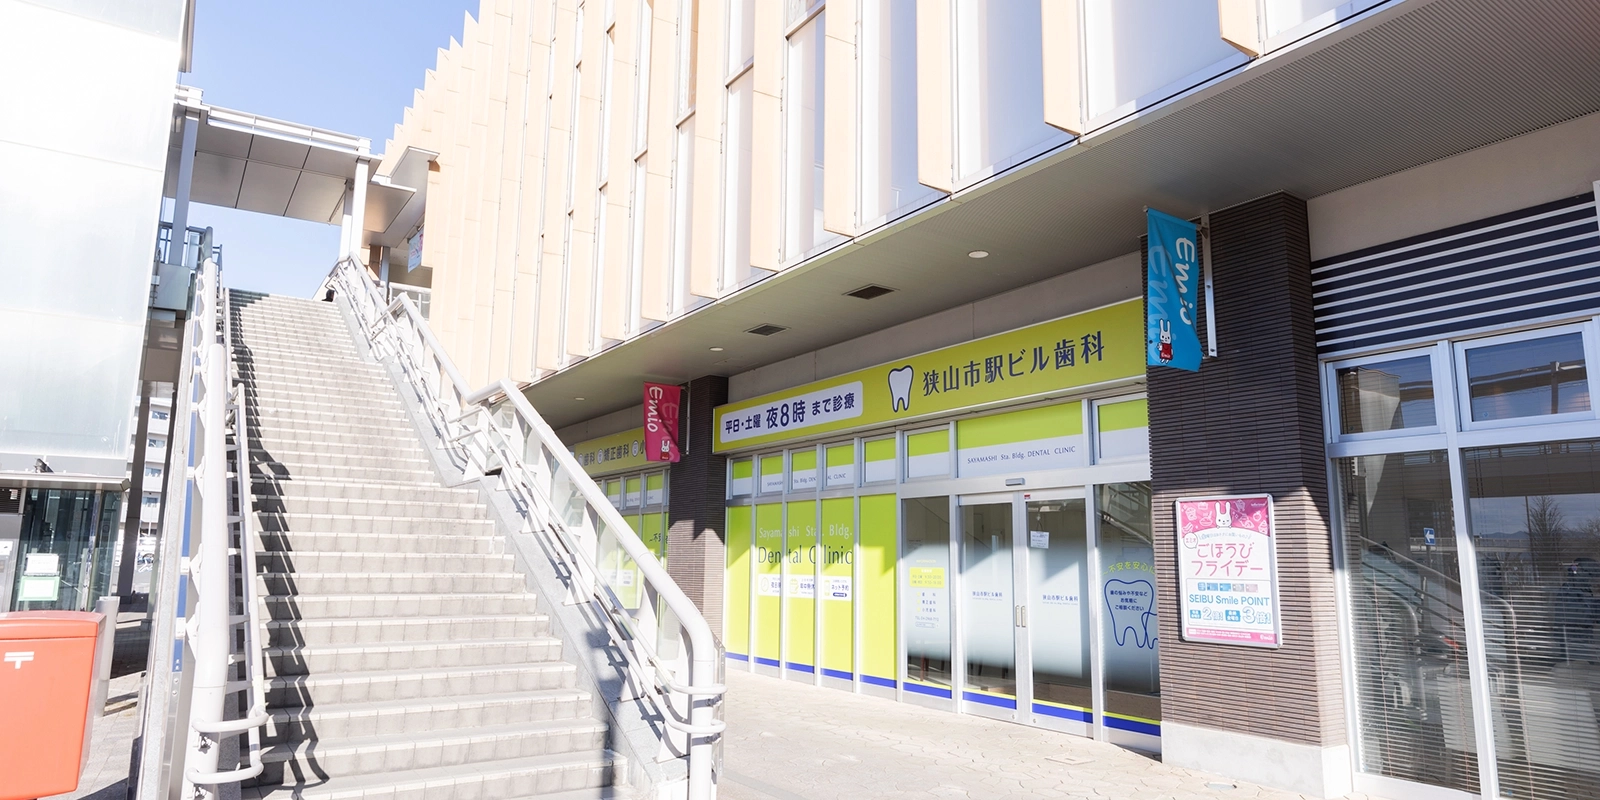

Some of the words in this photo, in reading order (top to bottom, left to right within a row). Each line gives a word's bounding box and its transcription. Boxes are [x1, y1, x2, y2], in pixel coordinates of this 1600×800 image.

[922, 331, 1105, 397] 狭山市駅ビル歯科
[647, 386, 663, 433] Emio
[725, 414, 761, 434] 平日・土曜
[766, 400, 806, 429] 夜8時
[812, 392, 855, 416] まで診療
[967, 455, 998, 465] SAYAMASHI
[1000, 453, 1010, 461] Sta.
[1012, 451, 1026, 460] Bldg.
[1027, 449, 1051, 458] DENTAL
[1054, 446, 1076, 456] CLINIC
[829, 524, 853, 540] Bldg.
[758, 545, 802, 564] Dental
[809, 545, 853, 565] Clinic
[1197, 542, 1255, 559] ごほうび
[1191, 560, 1263, 577] フライデー
[1189, 594, 1214, 604] SEIBU
[1215, 595, 1239, 605] Smile
[1241, 596, 1270, 607] POINT
